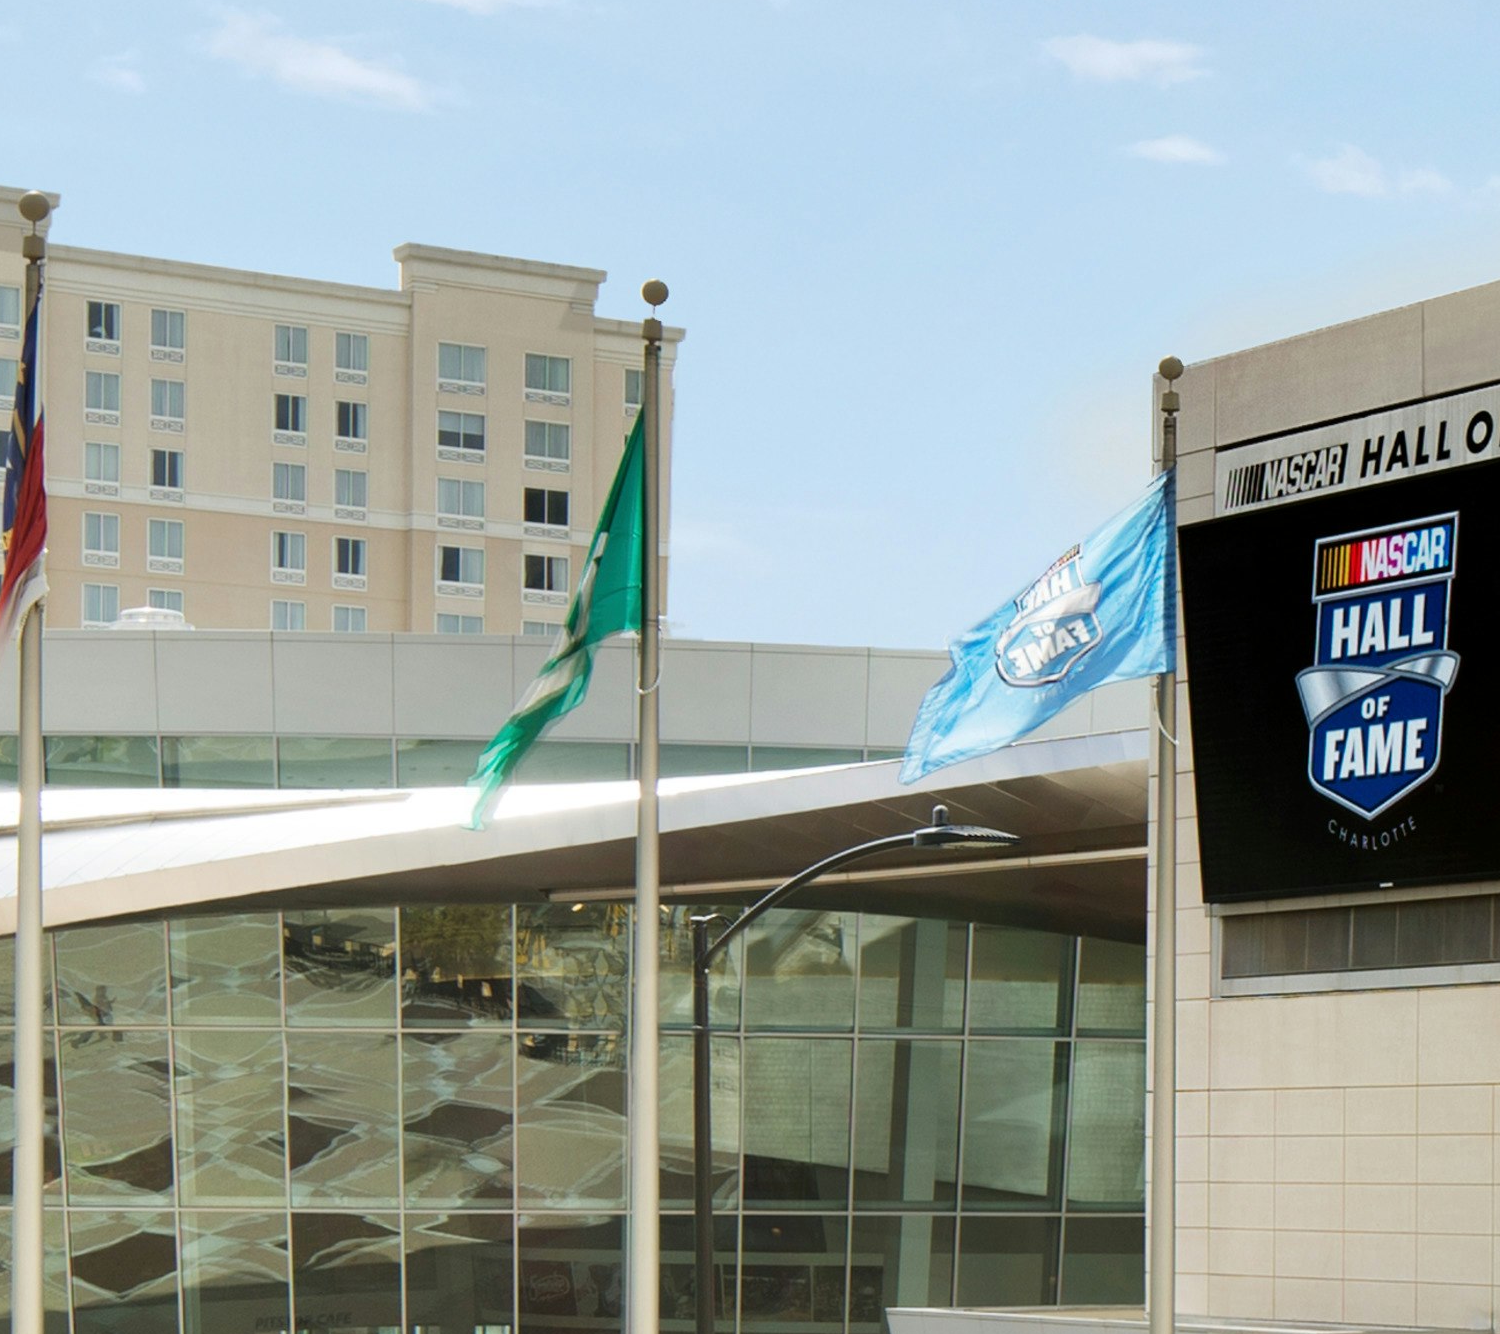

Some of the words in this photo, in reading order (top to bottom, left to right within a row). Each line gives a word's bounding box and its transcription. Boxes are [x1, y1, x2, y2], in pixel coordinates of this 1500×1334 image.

[1261, 444, 1345, 501] NASCAR
[1359, 420, 1451, 478] HALL
[1359, 526, 1446, 583] NASCAR
[1330, 593, 1434, 660] HALL
[1360, 695, 1391, 720] OF
[1322, 717, 1428, 782] FAME
[1327, 815, 1417, 851] CHARLOTTE
